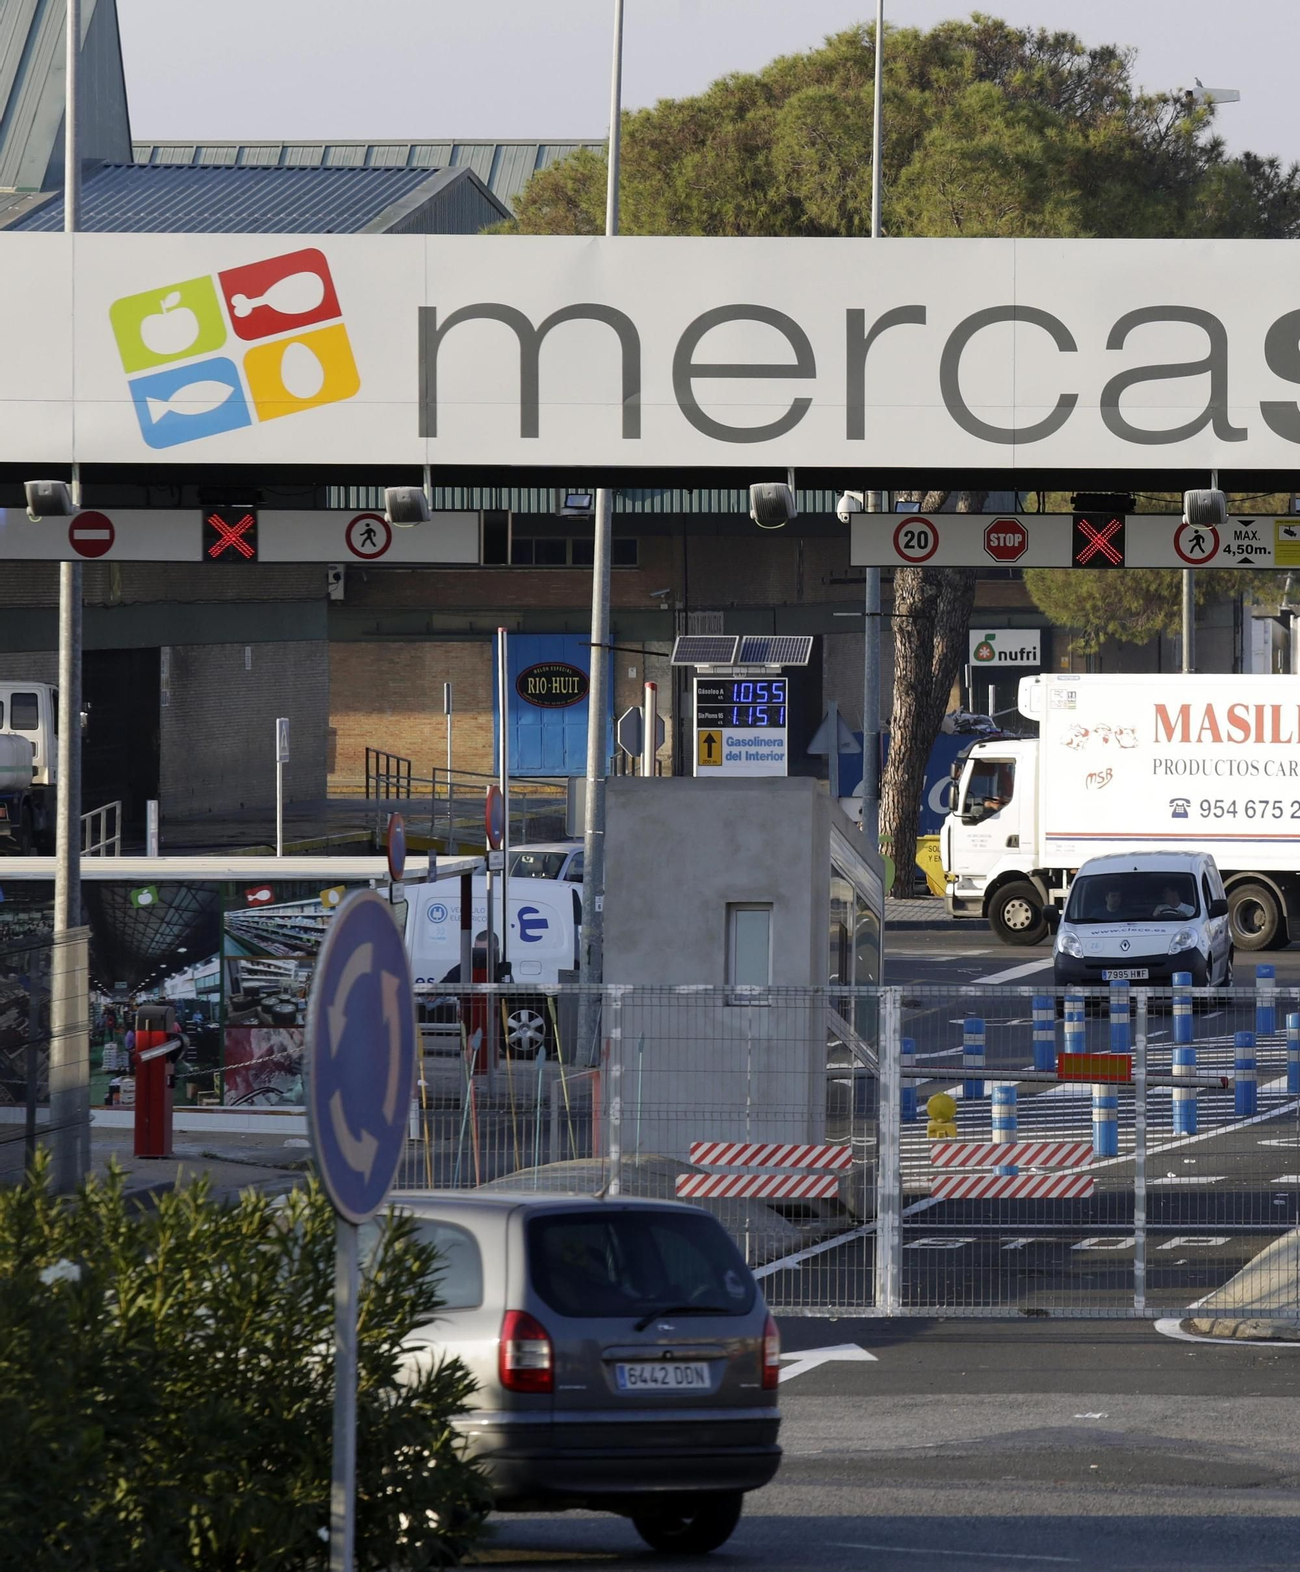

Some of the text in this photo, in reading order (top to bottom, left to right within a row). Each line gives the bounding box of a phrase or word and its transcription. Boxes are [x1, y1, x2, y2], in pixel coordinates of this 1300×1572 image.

[903, 530, 929, 549] 20
[989, 533, 1022, 547] STOP
[1233, 530, 1261, 541] MAX.
[1223, 544, 1271, 556] 4,50m.
[998, 646, 1037, 661] nufri
[733, 683, 784, 702] 1.055
[732, 706, 784, 725] 1.151
[726, 736, 784, 747] Gasolinera
[725, 751, 785, 761] del Interior
[1152, 758, 1260, 776] PRODUCTOS
[1199, 799, 1238, 819] 954
[1244, 800, 1284, 819] 675
[1107, 969, 1147, 979] 7995 HWF
[627, 1365, 706, 1386] 6442 DDN
